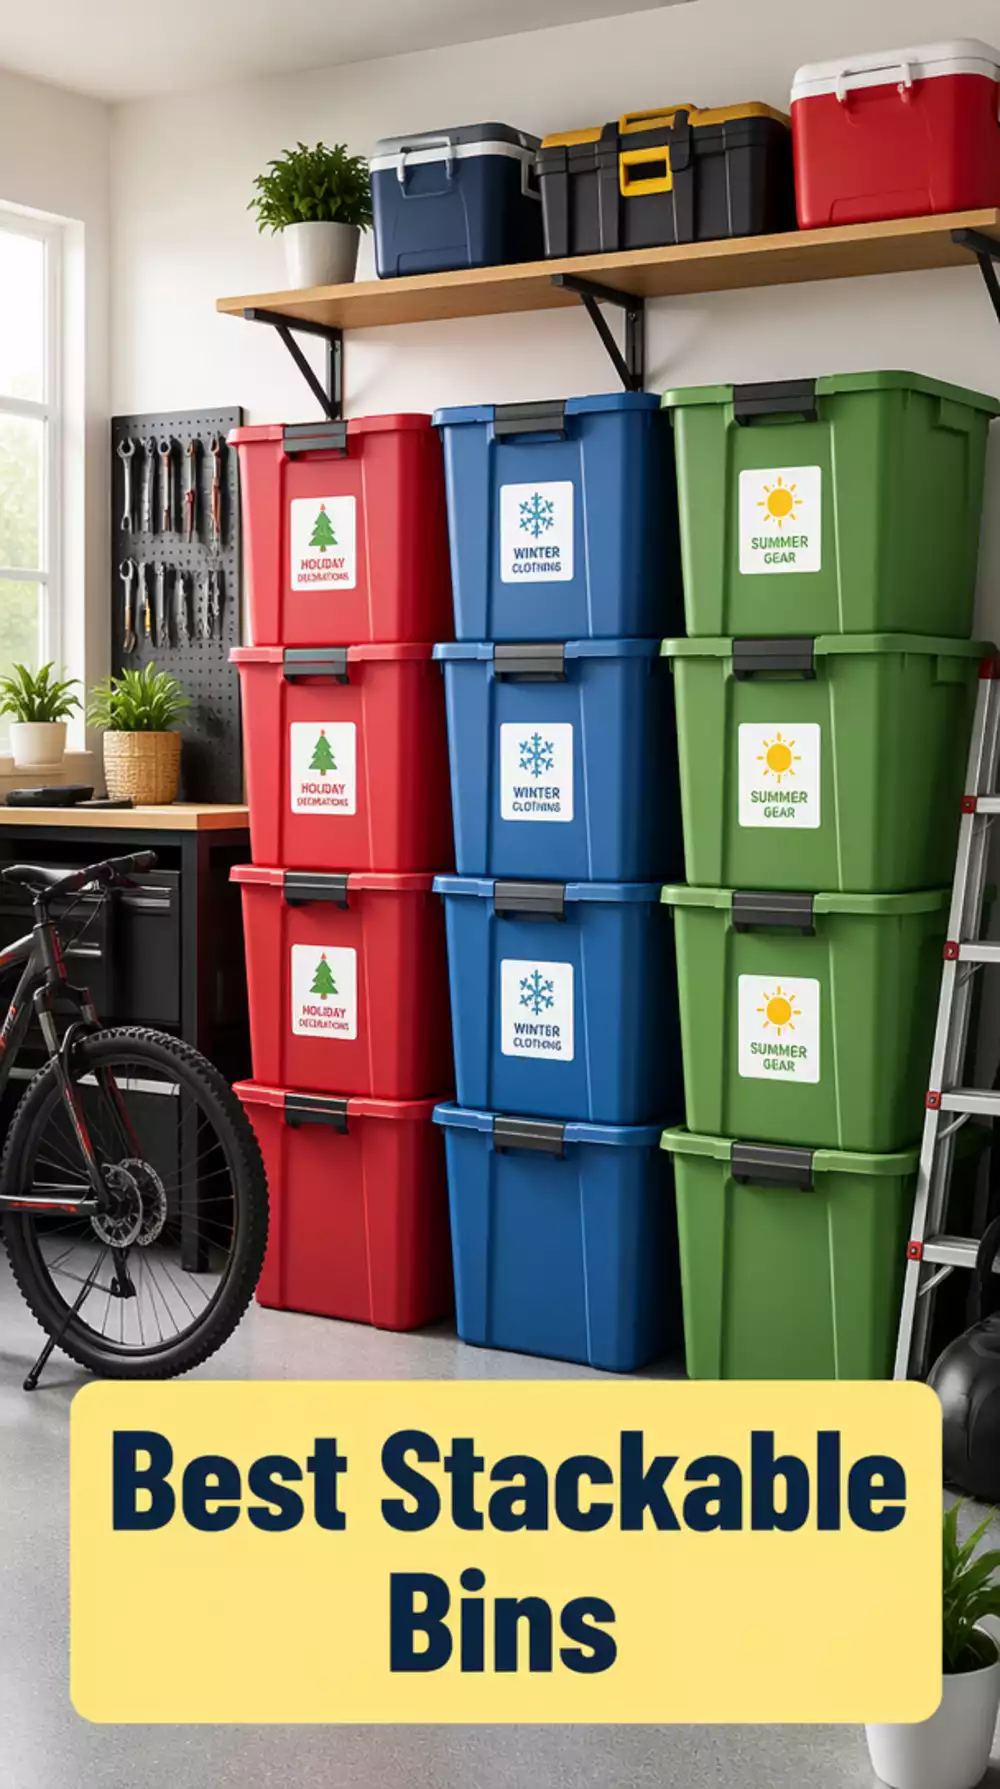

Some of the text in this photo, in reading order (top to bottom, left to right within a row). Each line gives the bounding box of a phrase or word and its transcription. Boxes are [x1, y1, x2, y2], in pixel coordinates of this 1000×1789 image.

[751, 535, 808, 550] SUMMER
[514, 546, 560, 559] WINTER
[764, 551, 796, 564] GEAR
[301, 558, 345, 570] HOLIDAY
[301, 783, 345, 795] HOLIDAY
[513, 786, 560, 800] WINTER
[750, 790, 808, 804] SUMMER
[763, 806, 796, 819] GEAR
[302, 1005, 346, 1018] HOLIDAY
[514, 1022, 560, 1037] WINTER
[751, 1042, 807, 1059] SUMMER
[763, 1058, 796, 1072] GEAR
